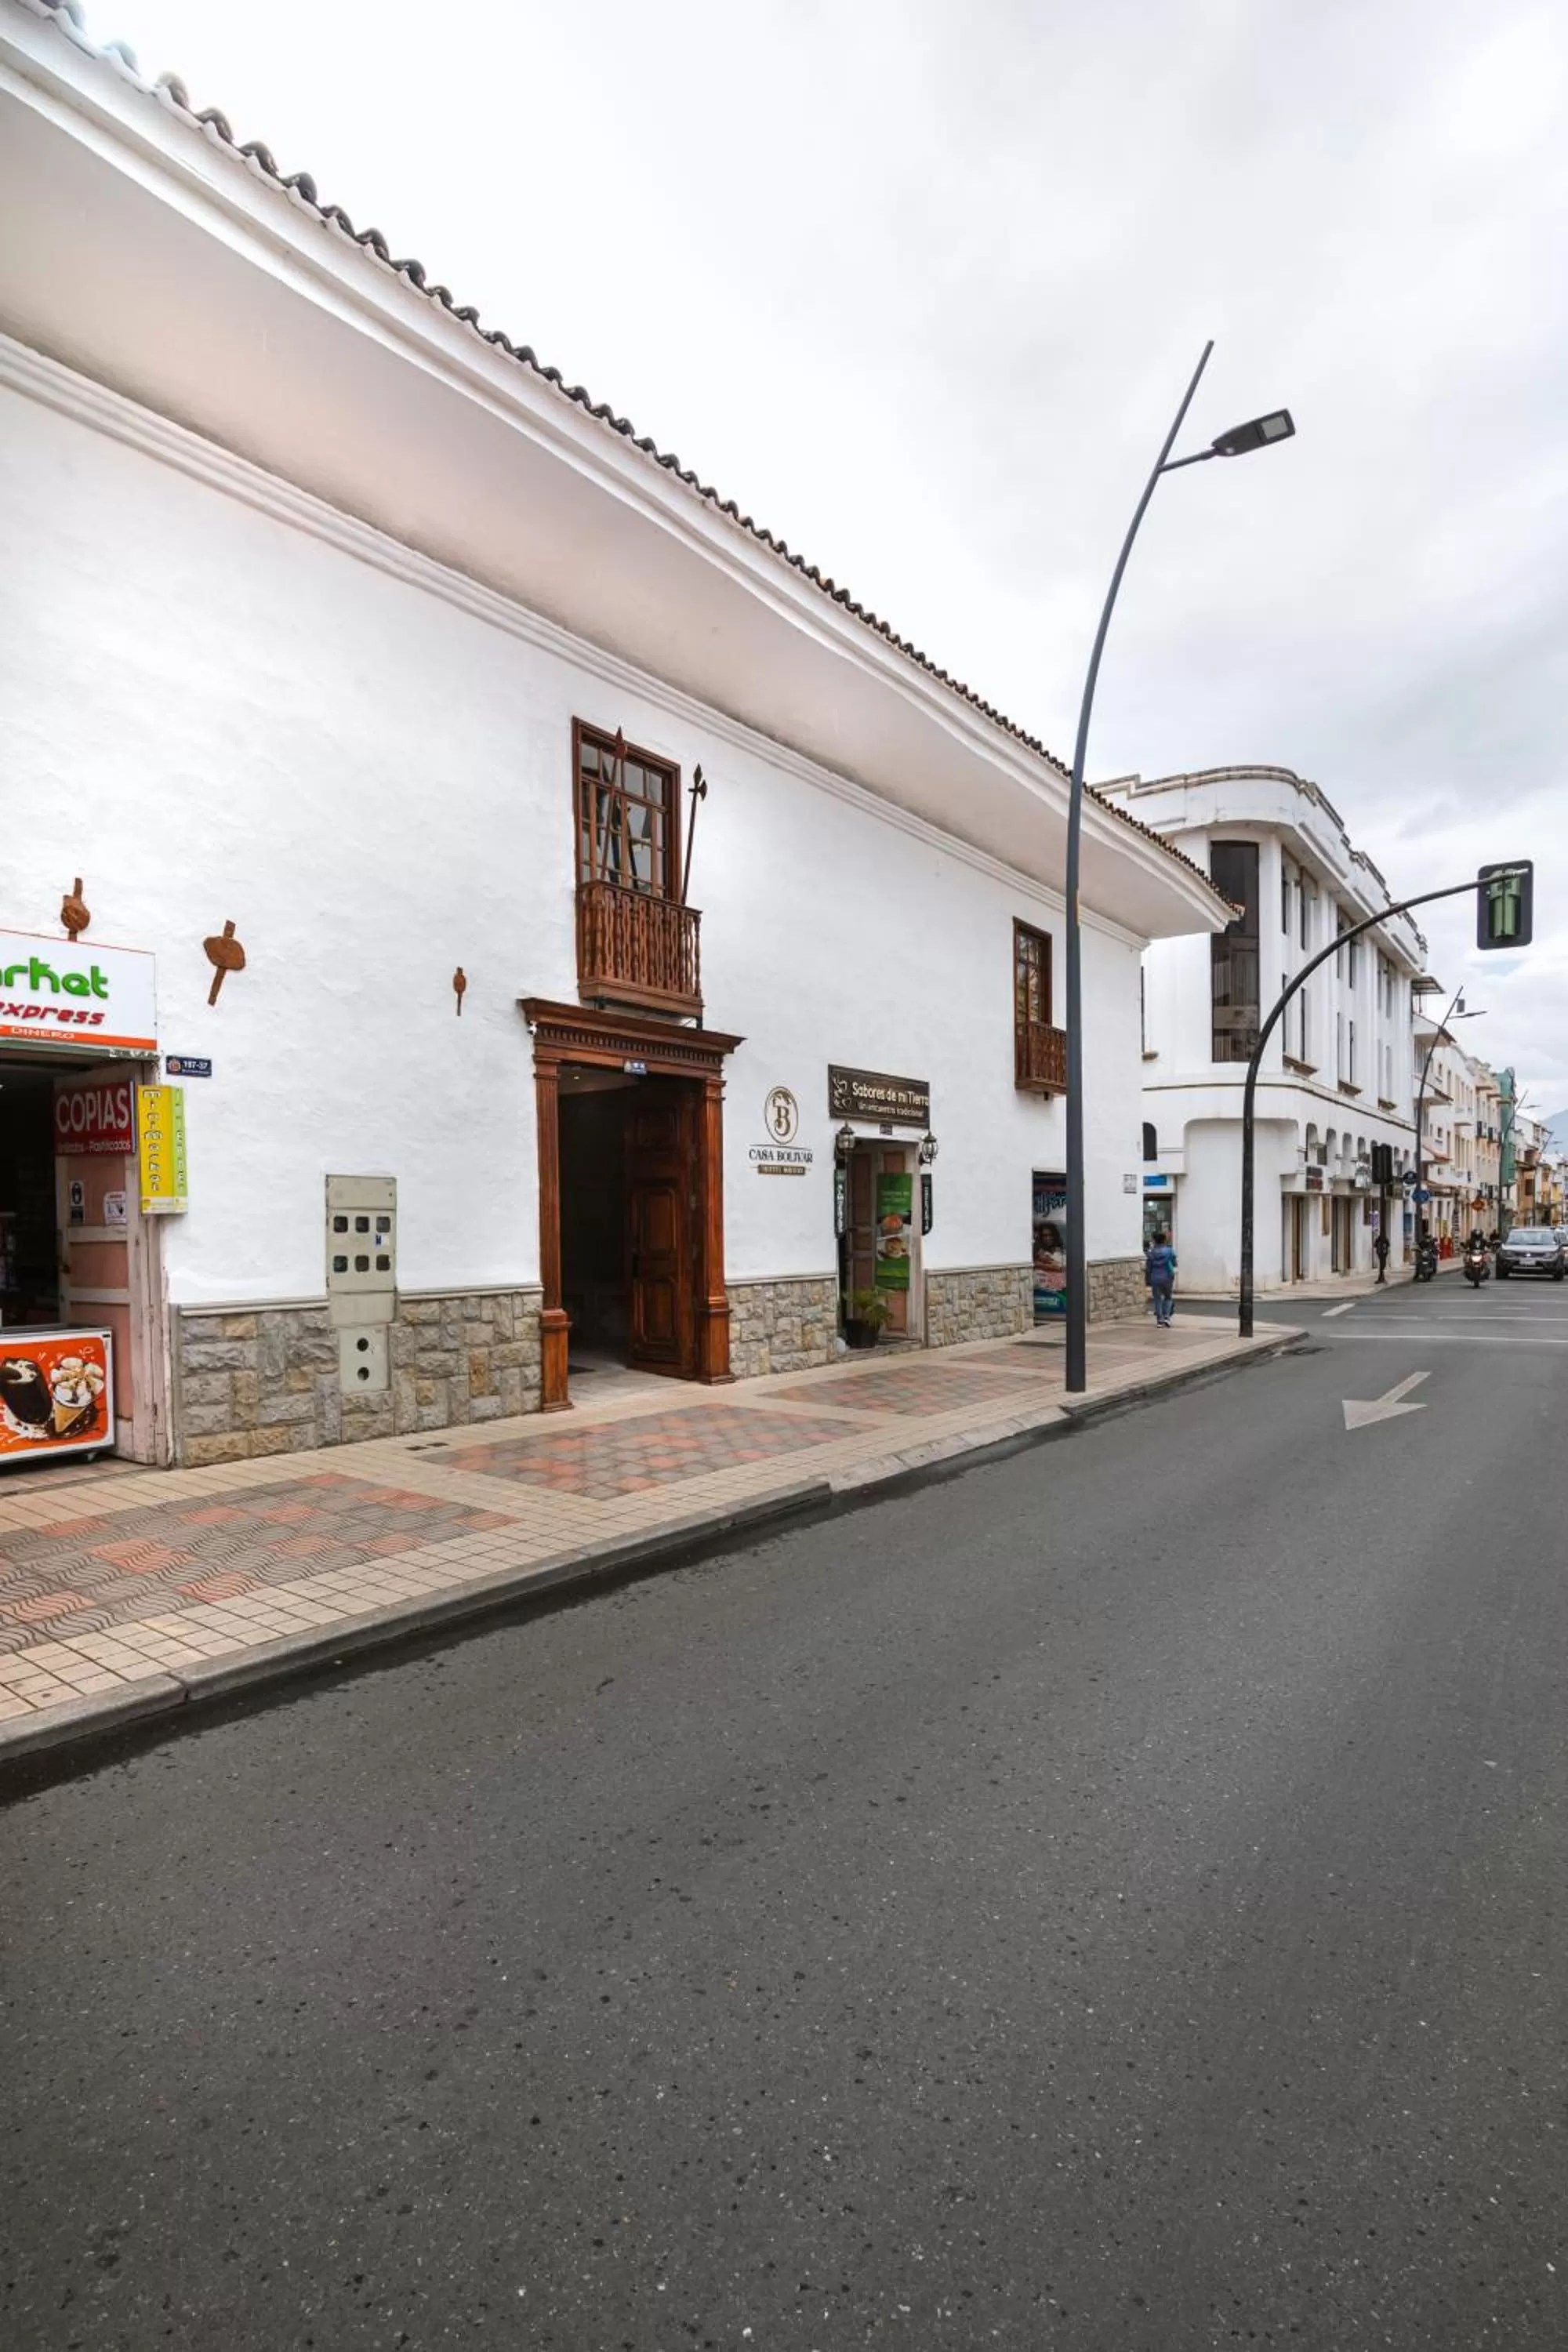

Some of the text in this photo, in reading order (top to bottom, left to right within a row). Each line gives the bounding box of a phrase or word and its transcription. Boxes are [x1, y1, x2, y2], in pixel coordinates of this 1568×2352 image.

[0, 956, 108, 999] rket
[10, 1027, 75, 1039] DINERO
[852, 1082, 885, 1100] Sabores
[886, 1088, 897, 1102] de
[898, 1091, 907, 1103] mi
[56, 1088, 129, 1134] COPIAS
[749, 1149, 774, 1160] CASA
